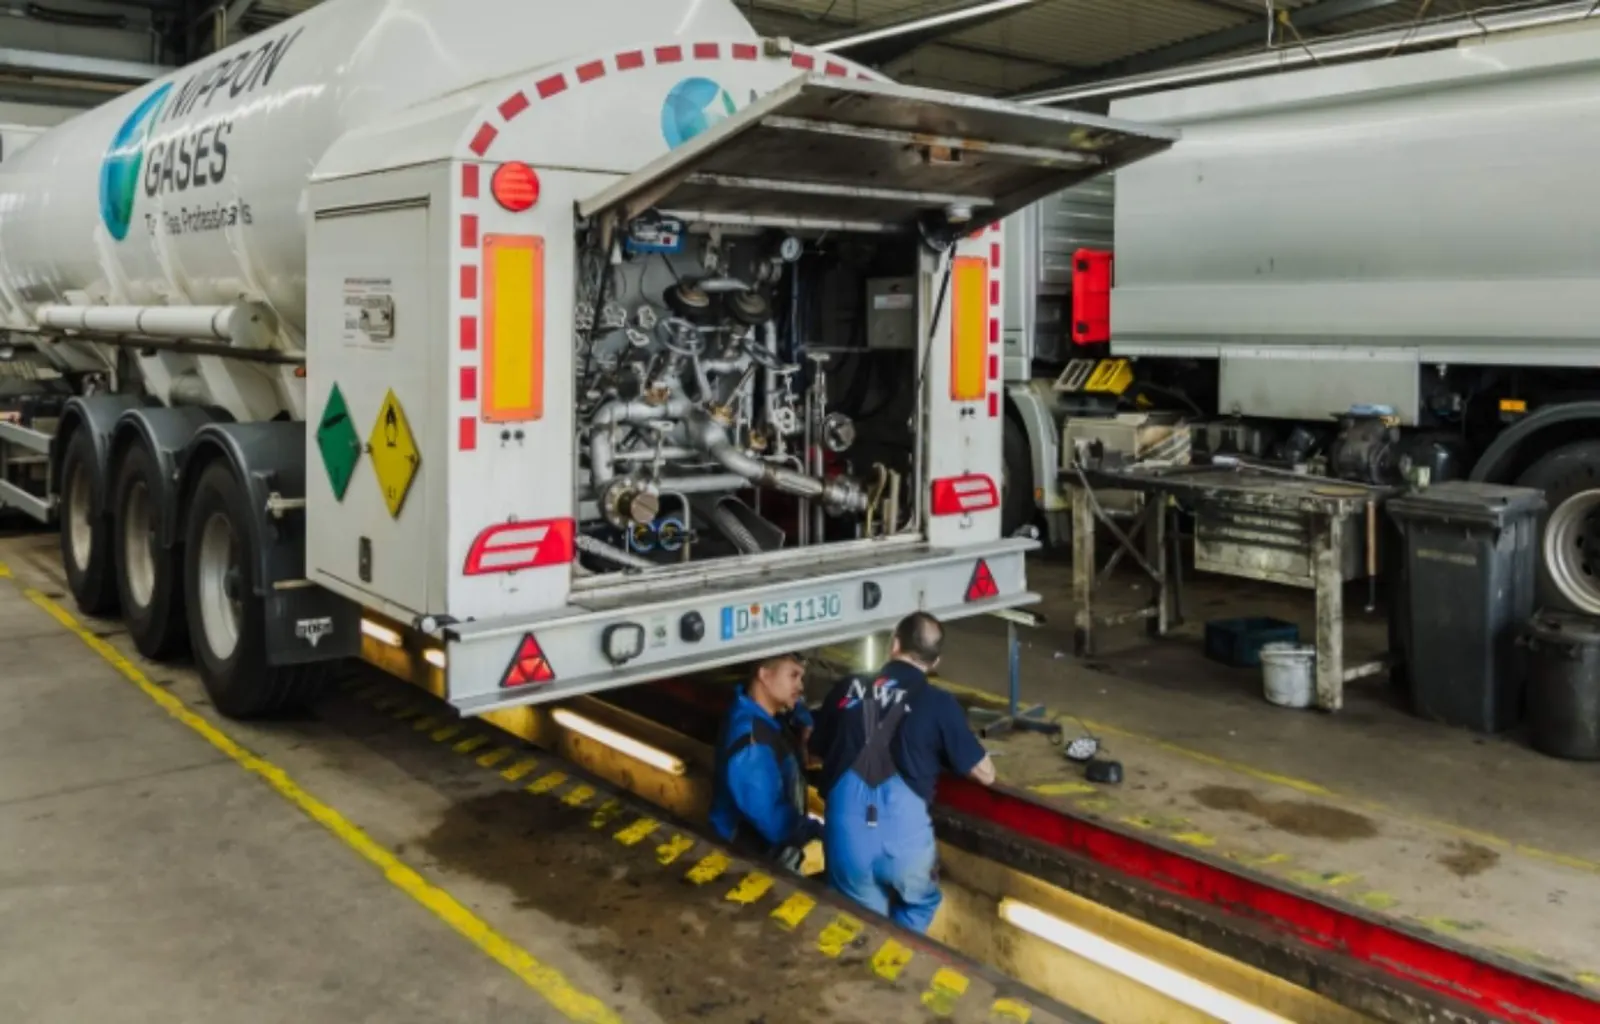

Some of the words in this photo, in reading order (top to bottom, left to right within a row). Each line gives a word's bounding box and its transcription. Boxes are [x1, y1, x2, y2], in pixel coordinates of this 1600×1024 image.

[161, 26, 304, 123] NIPPON
[145, 121, 232, 197] GASES
[736, 609, 748, 632] D
[763, 602, 788, 629] NG
[793, 594, 840, 623] 1130
